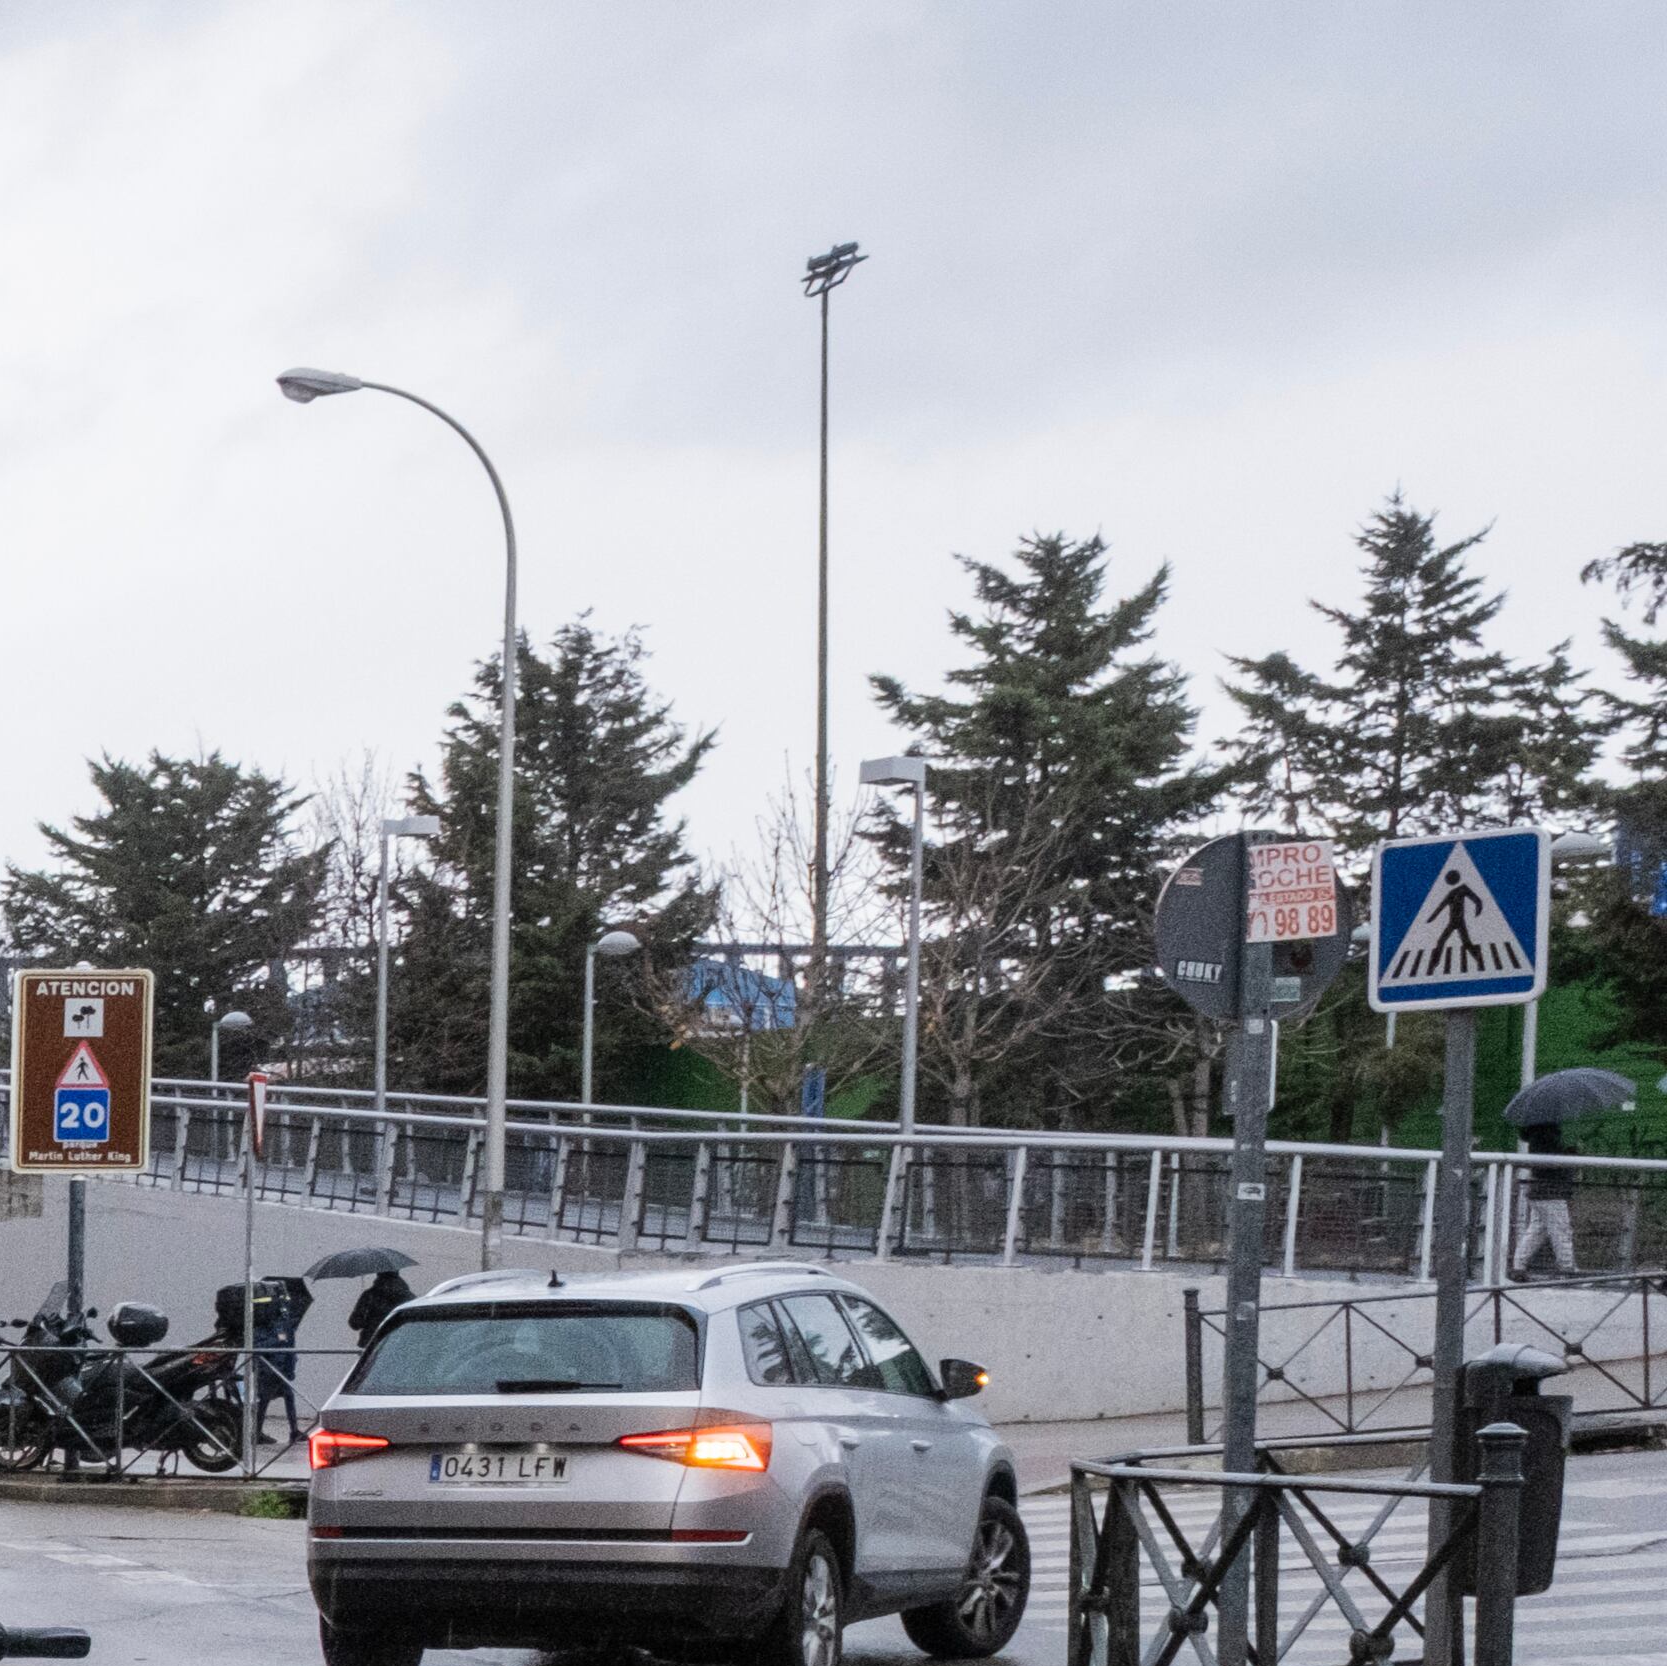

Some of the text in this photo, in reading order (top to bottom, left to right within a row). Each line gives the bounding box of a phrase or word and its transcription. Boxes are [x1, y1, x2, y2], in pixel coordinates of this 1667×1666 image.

[1308, 904, 1334, 934] 89
[36, 981, 135, 996] ATENCION
[59, 1102, 106, 1129] 20
[444, 1456, 567, 1478] 0431 LFW
